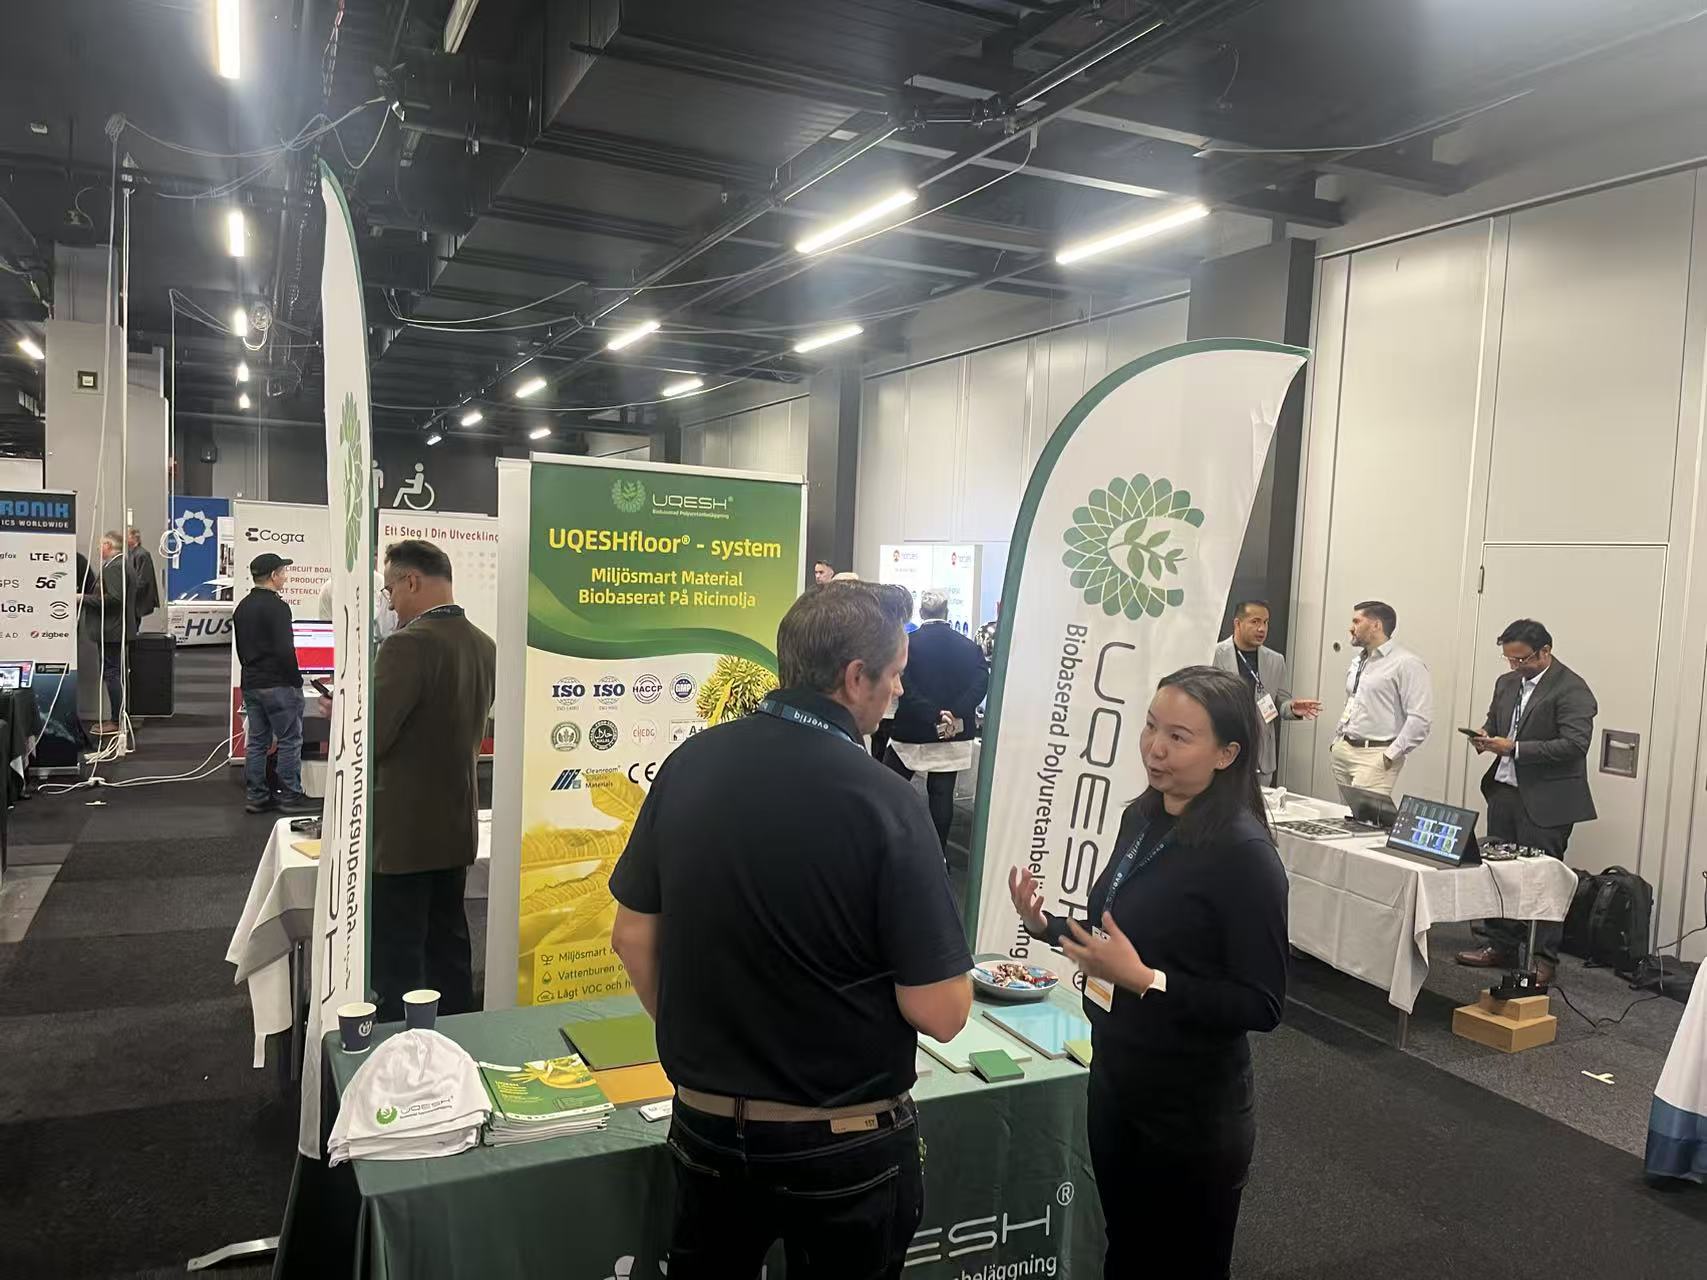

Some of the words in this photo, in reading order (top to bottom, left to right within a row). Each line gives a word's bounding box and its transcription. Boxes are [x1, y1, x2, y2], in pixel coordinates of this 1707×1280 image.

[19, 520, 69, 528] WORLDWIDE
[384, 525, 398, 536] Ett
[400, 526, 422, 539] Steg
[431, 528, 447, 539] Din
[259, 529, 305, 544] Cogra
[711, 537, 782, 561] system
[35, 576, 57, 589] 5G
[591, 567, 677, 586] Miljösmart
[681, 569, 743, 587] Material
[578, 588, 665, 606] Biobaserat
[669, 589, 689, 606] På
[693, 591, 756, 609] Ricinolja
[1, 603, 34, 613] LoRa
[41, 631, 70, 640] zigbee
[1046, 622, 1089, 738] Biobaserad
[552, 684, 585, 698] ISO
[593, 683, 625, 698] ISO
[632, 684, 663, 694] HACCP
[1009, 741, 1067, 960] Polyuretanbelng
[558, 946, 606, 964] Miljösmart
[557, 964, 615, 981] Vattenburen
[557, 988, 578, 1002] Lågt
[581, 984, 602, 995] VOC
[605, 979, 622, 991] och
[904, 1181, 1075, 1268] ESH®
[957, 1253, 1058, 1280] beläggning
